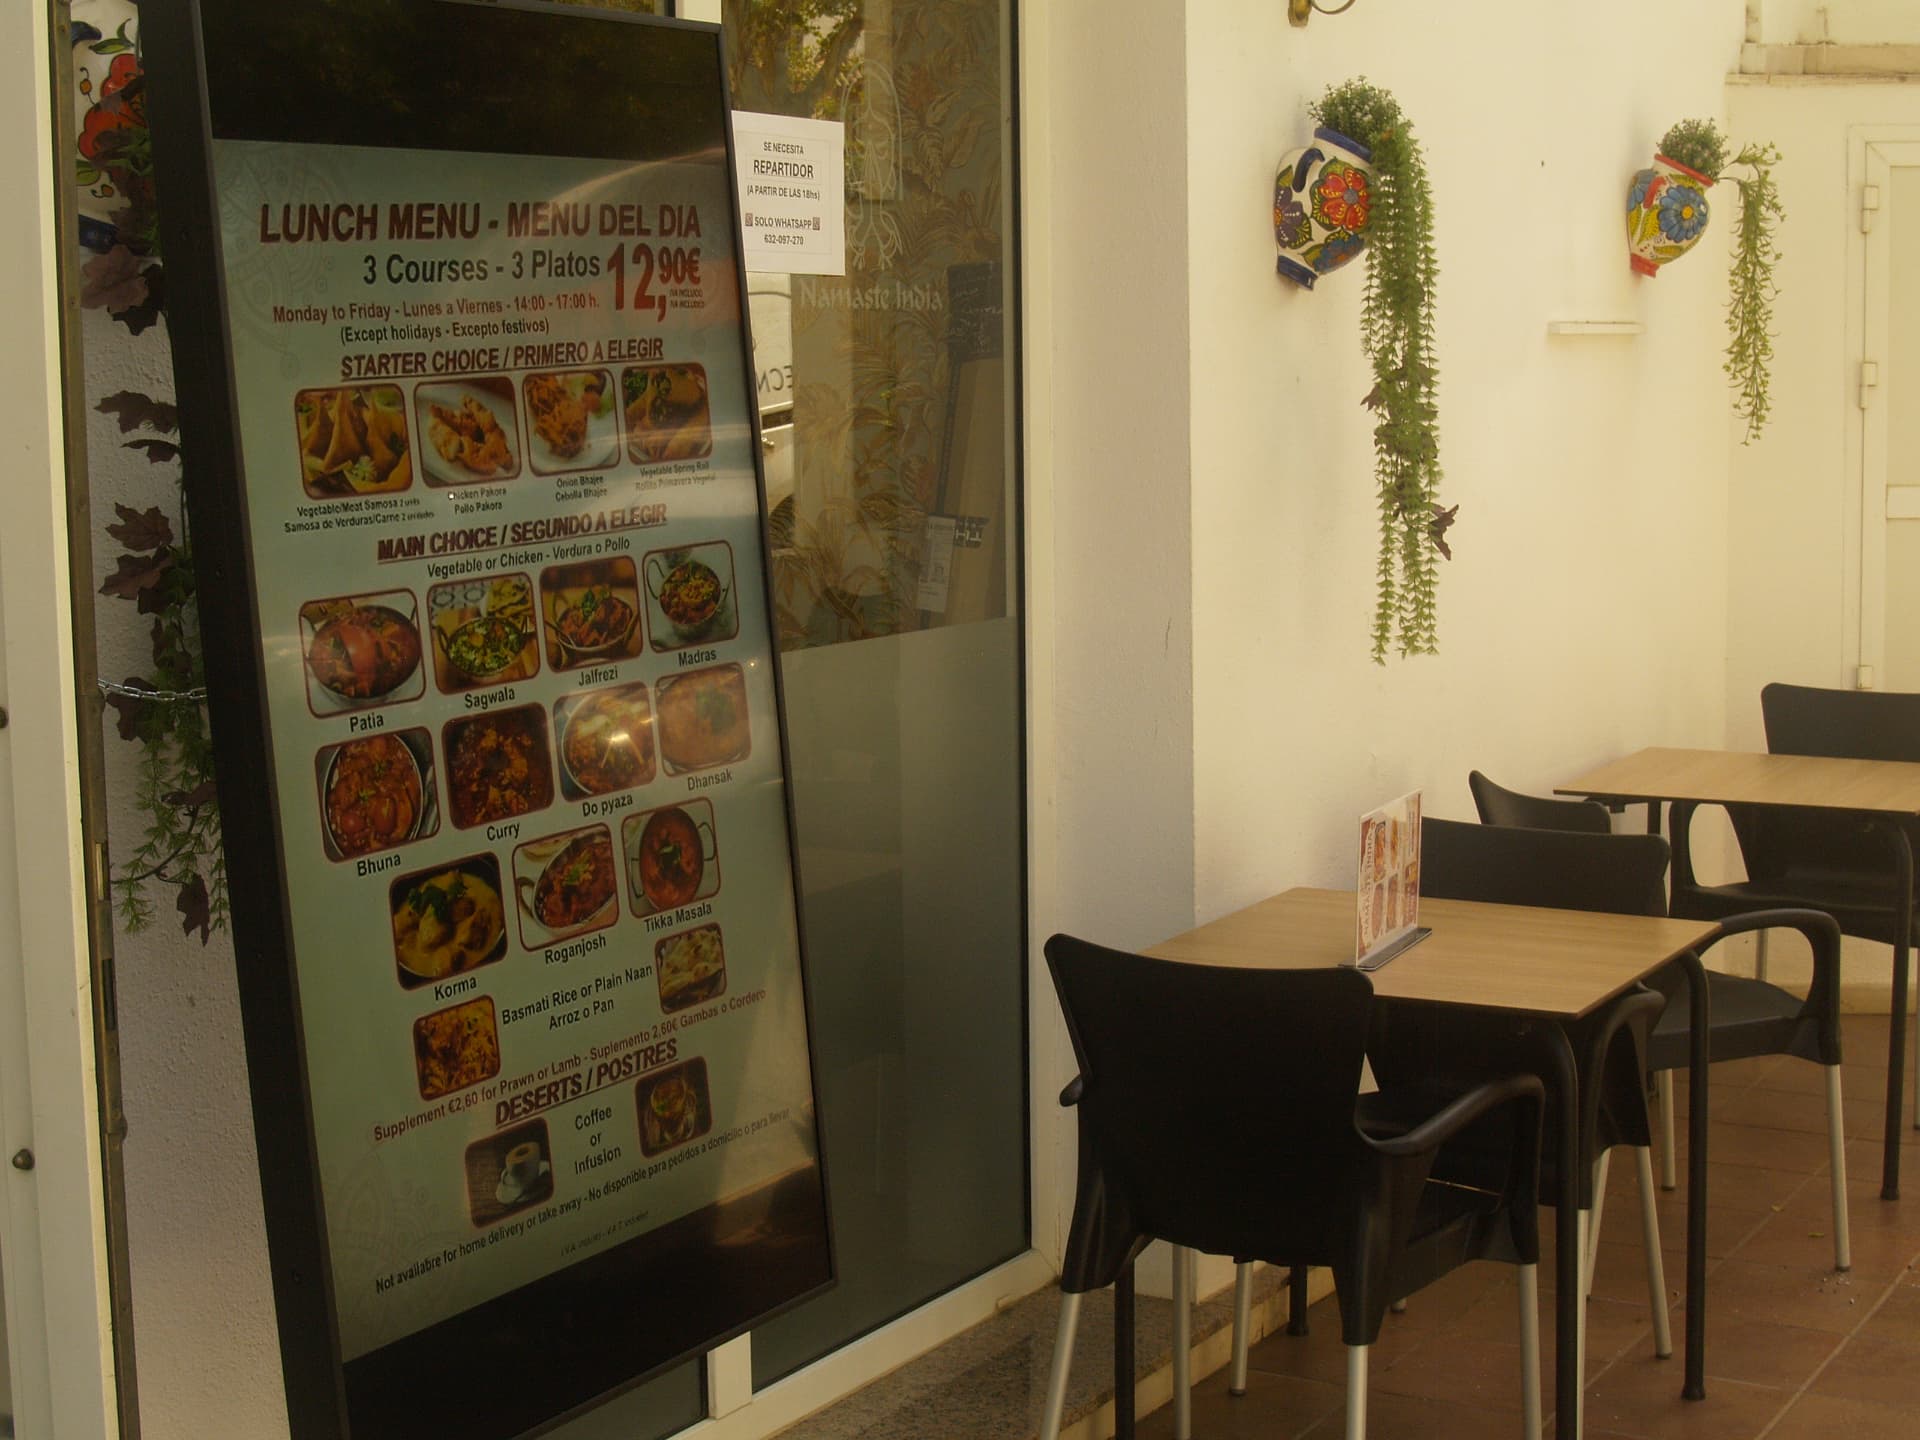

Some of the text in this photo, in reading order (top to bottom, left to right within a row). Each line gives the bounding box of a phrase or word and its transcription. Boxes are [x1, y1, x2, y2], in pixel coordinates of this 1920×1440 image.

[763, 141, 804, 155] SE NECESITA
[753, 160, 815, 179] REPARTIDOR
[755, 185, 778, 197] PARTIR
[779, 187, 788, 197] DE
[789, 187, 801, 198] LAS
[260, 203, 379, 243] LUNCH
[388, 202, 480, 240] MENU
[507, 202, 591, 238] MENU
[600, 203, 652, 237] DEL
[659, 203, 702, 238] DIA
[754, 216, 812, 229] SOLO WHATSAPP
[763, 233, 804, 246] 632-097-270
[363, 254, 377, 285] 3
[386, 253, 489, 284] Courses
[511, 249, 524, 280] 3
[532, 248, 600, 280] Platos
[800, 278, 943, 311] Namaste India
[272, 304, 328, 325] Monday
[332, 303, 346, 319] to
[349, 302, 391, 321] Friday
[402, 300, 443, 318] Lunes
[447, 303, 454, 315] a
[456, 297, 503, 316] Viernes
[514, 295, 545, 312] 14:00
[557, 294, 586, 311] 17:00
[341, 326, 388, 345] (Except
[391, 323, 442, 342] holidays
[453, 320, 499, 340] Excepto
[501, 317, 550, 335] festivos)
[341, 352, 428, 378] STARTER
[432, 347, 499, 373] CHOICE
[514, 341, 589, 367] PRIMERO
[593, 343, 604, 361] A
[607, 338, 664, 360] ELEGIR
[556, 478, 578, 489] Onion
[640, 466, 672, 478] Vegetable
[480, 487, 507, 498] Pakora
[364, 499, 398, 511] Samosa
[454, 501, 503, 516] Pollo Pakora
[284, 521, 320, 534] Samosa
[322, 519, 333, 529] de
[377, 535, 426, 561] MAIN
[429, 526, 498, 553] CHOICE
[510, 513, 593, 542] SEGUNDO
[595, 511, 607, 531] A
[611, 503, 668, 528] ELEGIR
[426, 562, 482, 580] Vegetable
[485, 558, 496, 570] or
[500, 551, 543, 571] Chicken
[552, 543, 593, 560] Verdura
[596, 543, 602, 553] o
[604, 538, 631, 552] Pollo
[677, 648, 717, 668] Madras
[578, 665, 619, 687] Jalfrezi
[463, 686, 516, 710] Sagwala
[349, 713, 384, 732] Patia
[687, 769, 733, 791] Dhansak
[581, 793, 633, 817] Do pyaza
[486, 822, 520, 841] Curry
[356, 853, 402, 877] Bhuna
[643, 902, 713, 934] Tikka Masala
[544, 934, 607, 965] Roganjosh
[434, 976, 478, 1001] Korma
[501, 963, 653, 1025] Basmati Rice or Plain Naan
[548, 997, 615, 1032] Arroz o Pan
[373, 1106, 446, 1141] Supplement
[481, 1084, 497, 1103] for
[500, 1074, 535, 1094] Prawn
[537, 1066, 549, 1082] or
[551, 1055, 582, 1075] Lamb
[590, 1031, 650, 1061] Suplemento
[680, 1009, 719, 1028] Gambas
[720, 1002, 728, 1013] o
[729, 989, 767, 1010] Cordero
[495, 1073, 583, 1126] DESERTS
[596, 1037, 678, 1086] POSTRES
[574, 1106, 613, 1131] Coffee
[589, 1131, 603, 1147] or
[573, 1145, 622, 1175] Infusion
[375, 1276, 395, 1295] Not
[442, 1248, 458, 1264] for
[459, 1237, 486, 1257] home
[488, 1221, 525, 1246] delivery
[526, 1215, 537, 1229] or
[537, 1206, 558, 1225] take
[559, 1196, 581, 1216] away
[588, 1186, 602, 1202] No
[603, 1168, 647, 1196] disponible
[647, 1161, 667, 1179] para
[667, 1146, 700, 1170] pedidos
[701, 1142, 707, 1153] a
[744, 1125, 750, 1135] o
